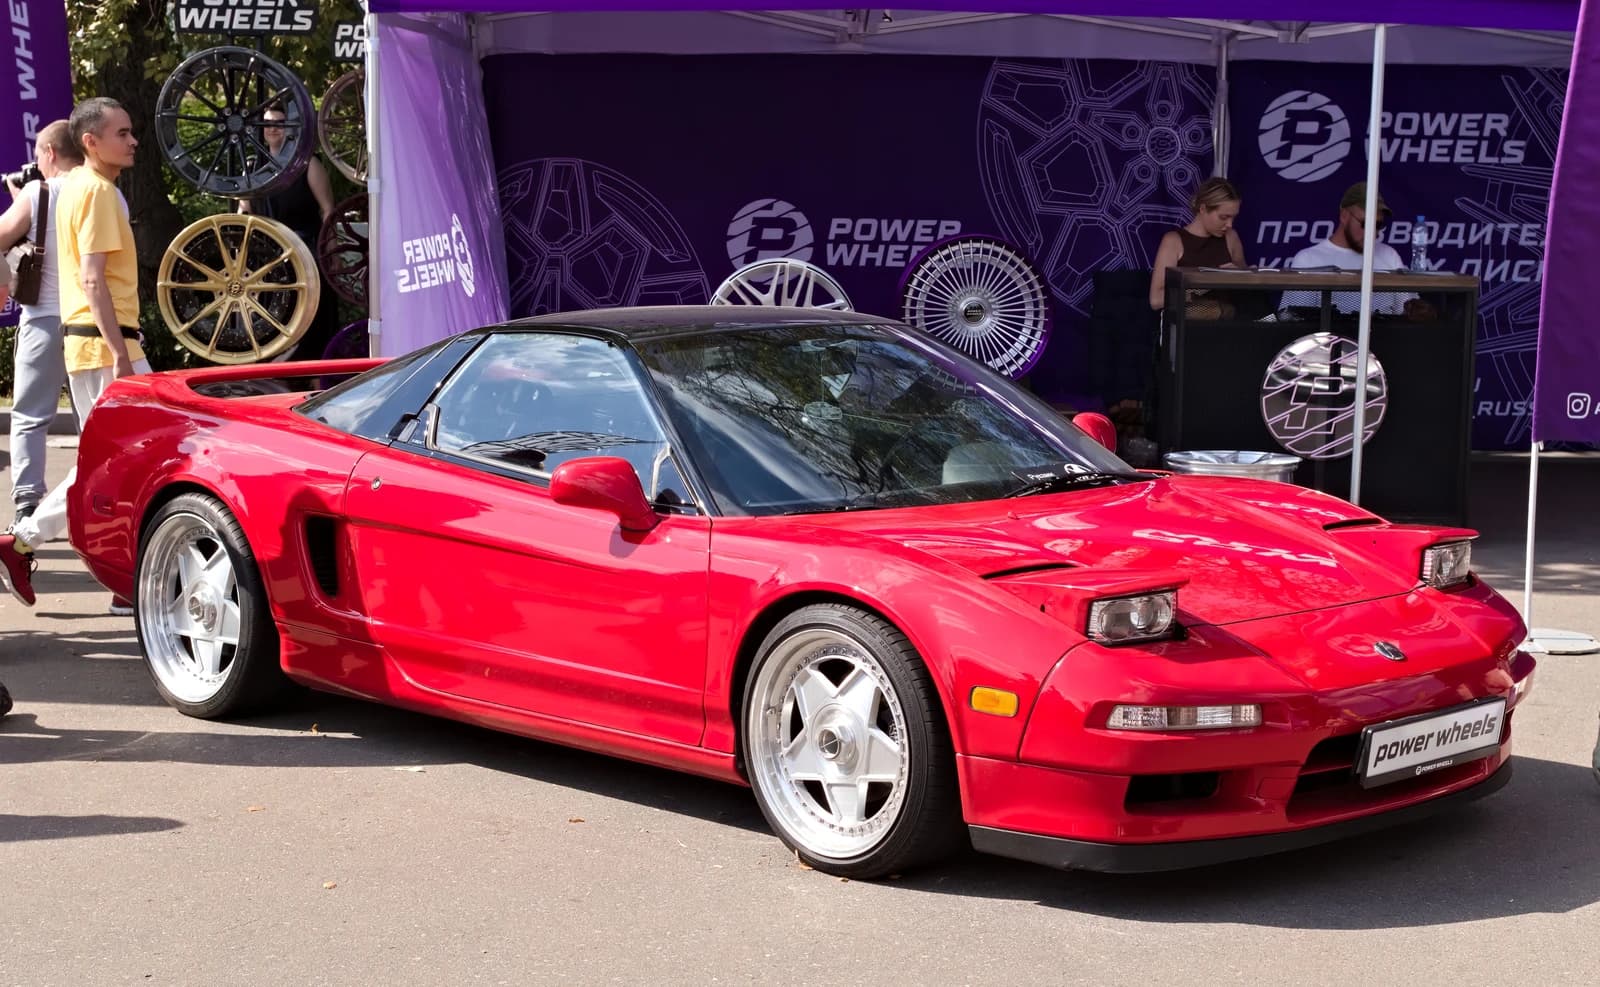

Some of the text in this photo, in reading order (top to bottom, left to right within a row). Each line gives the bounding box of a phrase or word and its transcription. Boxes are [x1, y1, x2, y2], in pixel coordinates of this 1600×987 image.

[179, 9, 314, 31] WHEELS
[1366, 111, 1510, 137] POWER
[1364, 137, 1526, 163] WHEELS
[1373, 713, 1497, 768] power wheels
